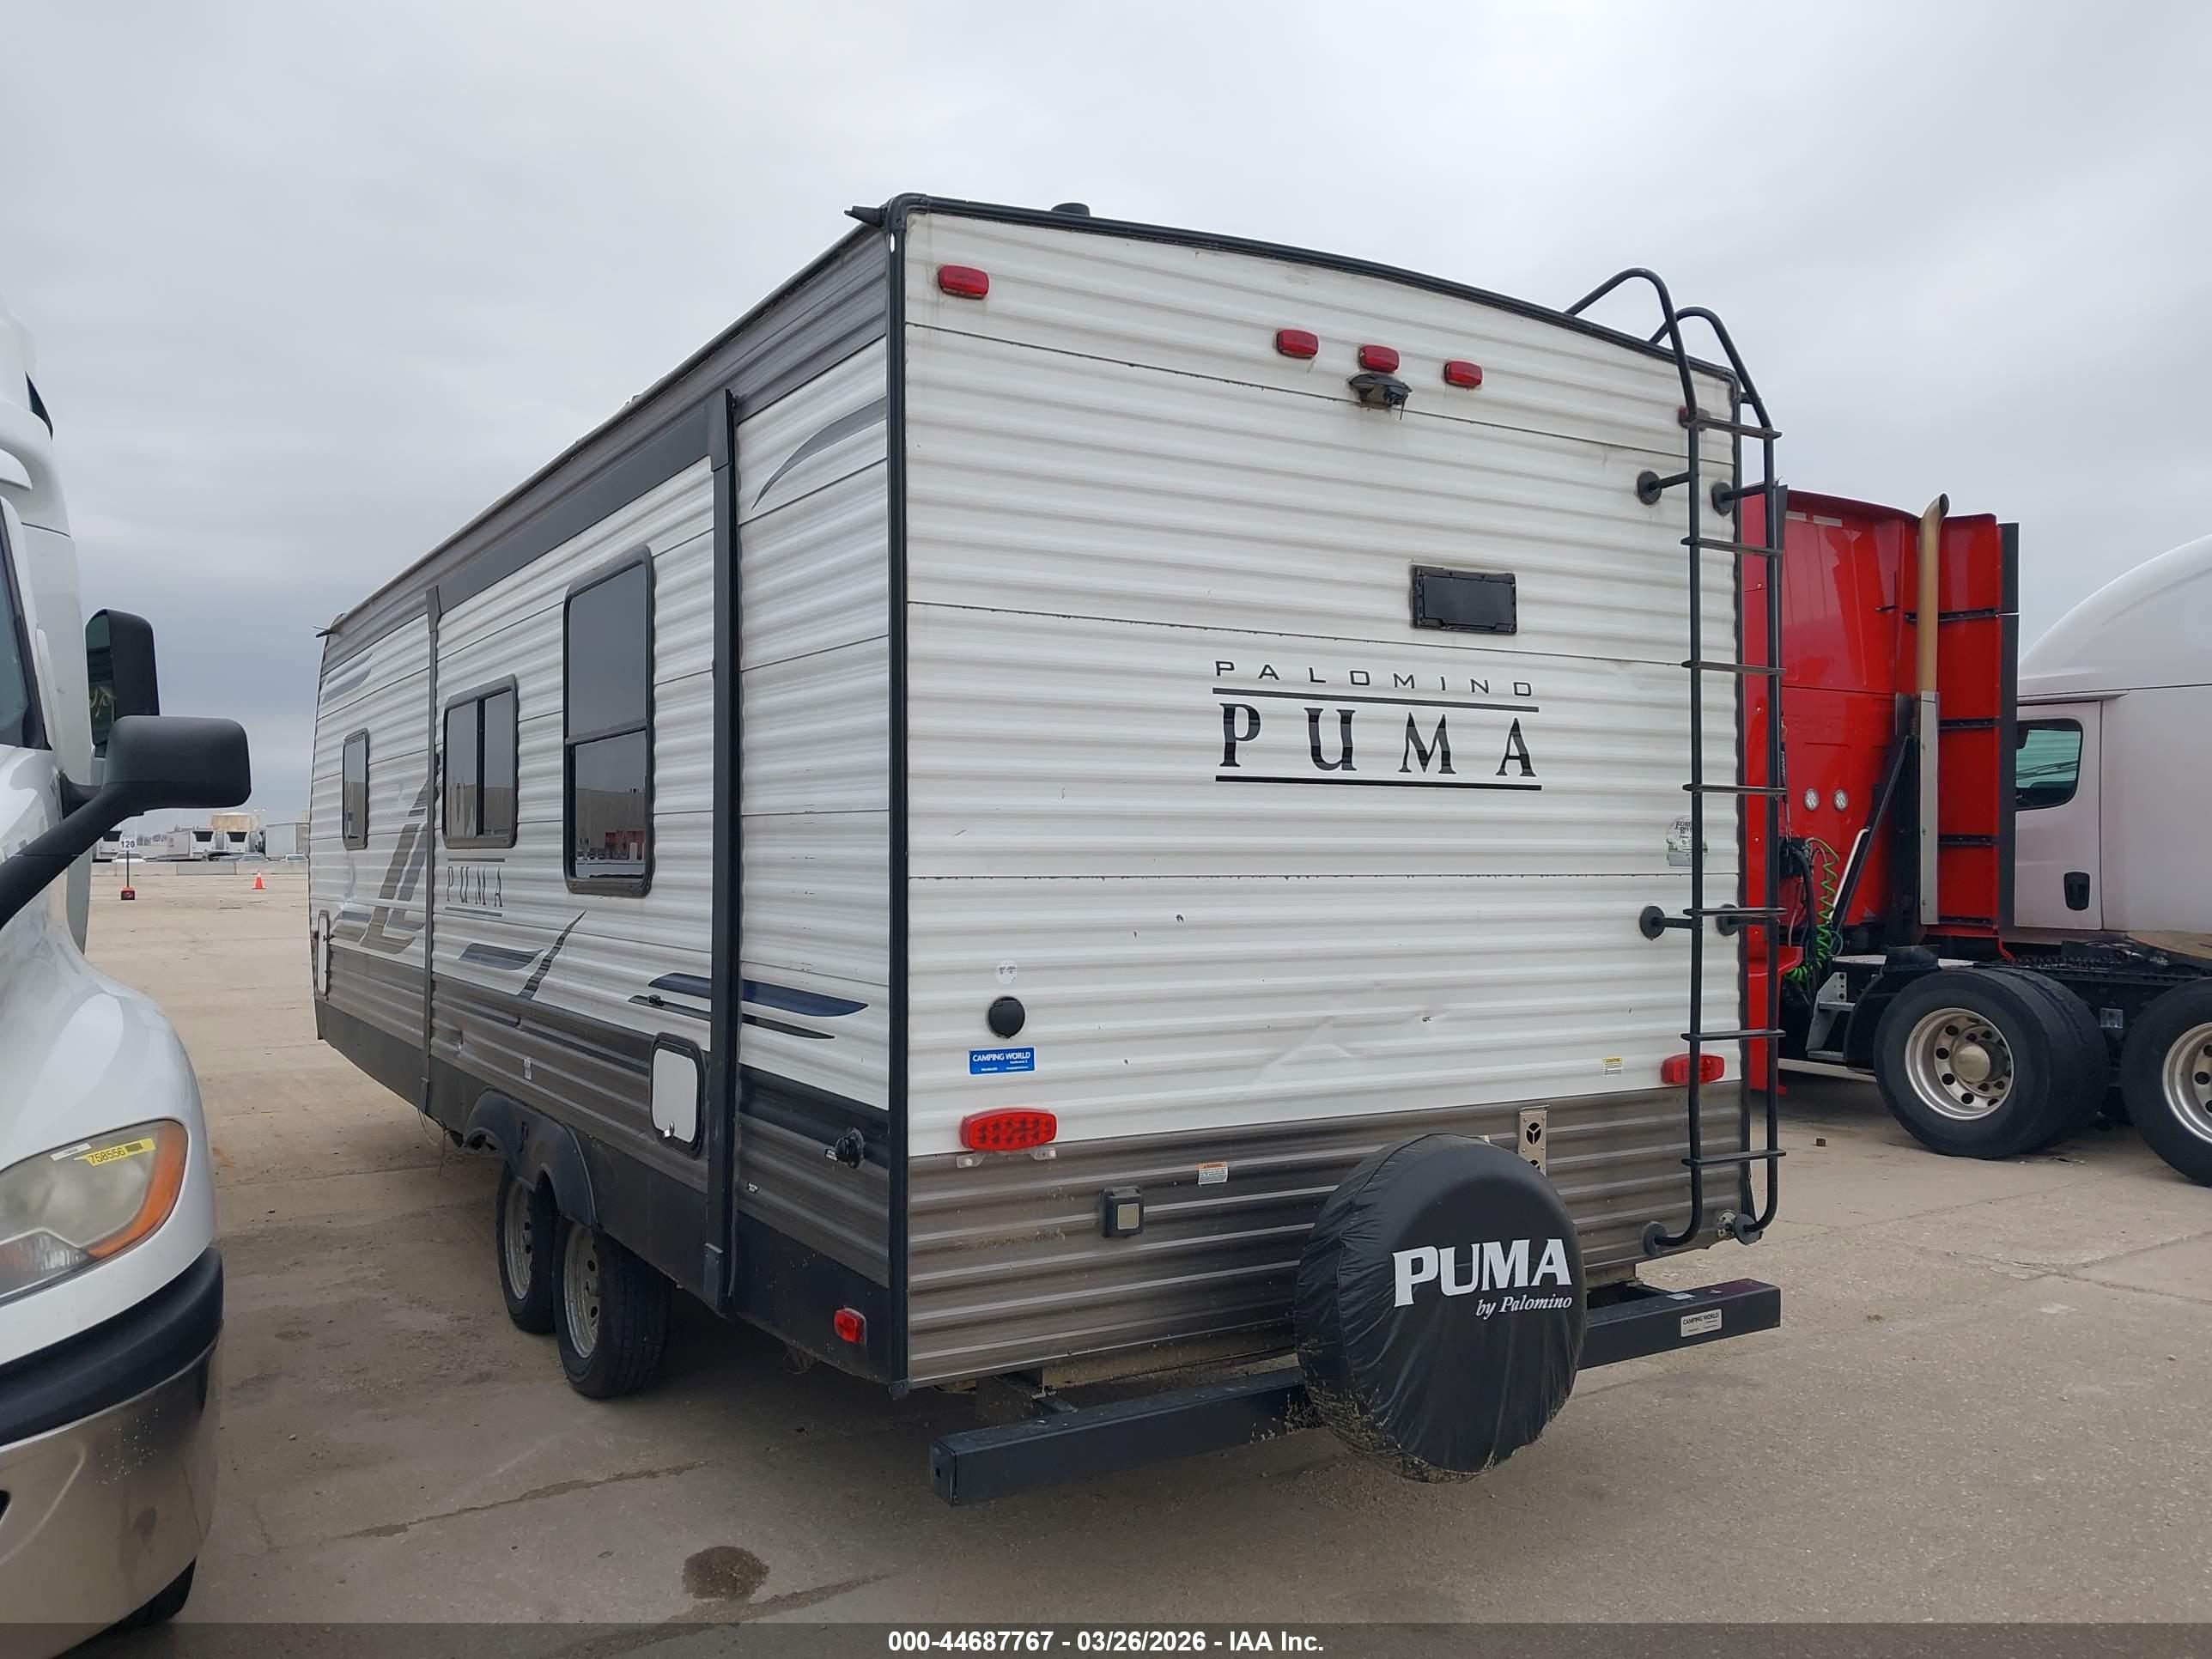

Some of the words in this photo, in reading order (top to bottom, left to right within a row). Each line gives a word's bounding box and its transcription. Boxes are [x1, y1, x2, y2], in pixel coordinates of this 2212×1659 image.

[1214, 660, 1533, 696] PALOMINO
[1218, 702, 1538, 778] PUMA
[120, 840, 135, 848] 120
[447, 866, 503, 908] PUMA
[972, 1053, 1005, 1062] CAMPING
[1005, 1051, 1031, 1060] WORLD
[88, 1147, 125, 1164] 758556
[1392, 1238, 1572, 1308] PUMA
[1475, 1299, 1497, 1320] by
[1498, 1293, 1572, 1313] Palomino
[1682, 1316, 1703, 1325] CAMPING
[1703, 1312, 1719, 1321] WORLD
